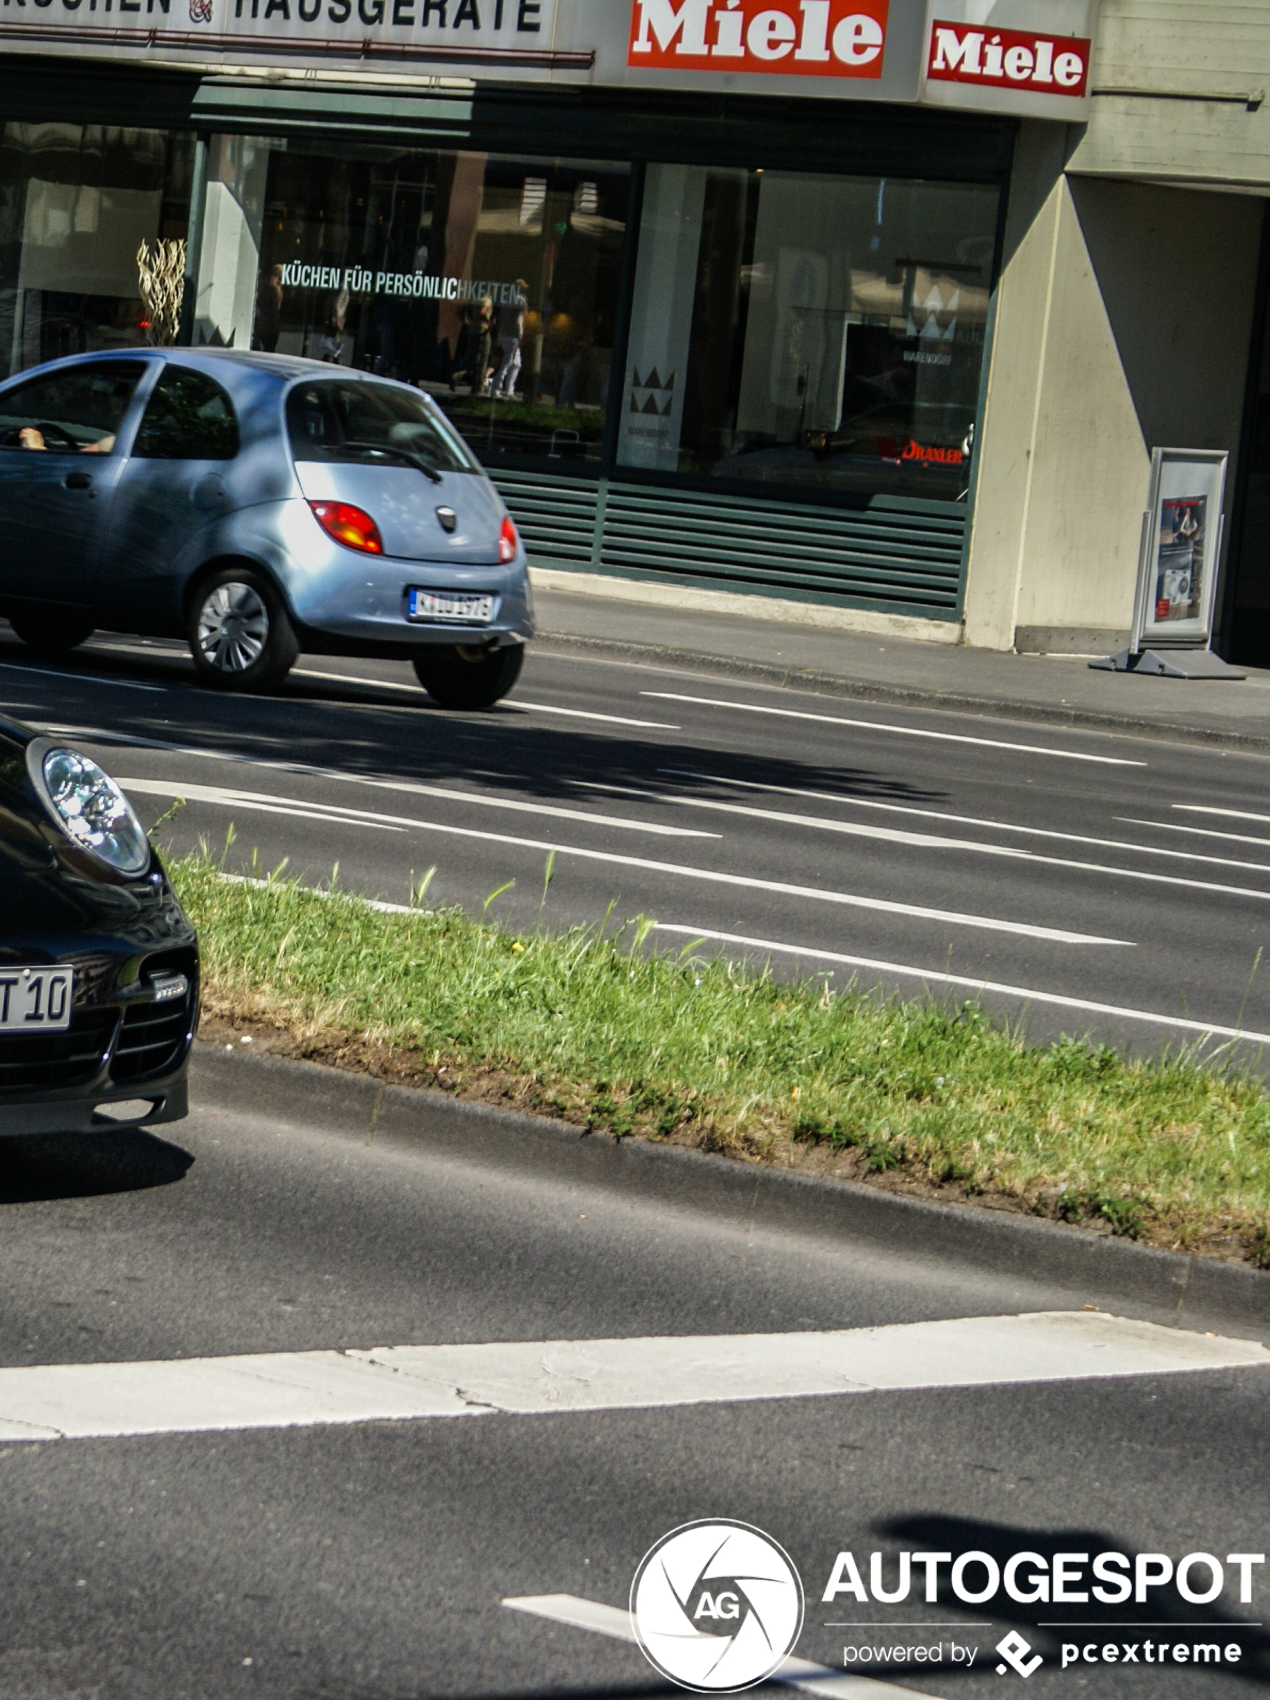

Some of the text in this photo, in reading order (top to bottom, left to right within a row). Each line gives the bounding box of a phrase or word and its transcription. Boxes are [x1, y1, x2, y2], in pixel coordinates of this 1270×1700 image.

[632, 0, 884, 65] Miele
[932, 28, 1084, 86] Miele
[281, 260, 341, 289] KÜCHEN
[343, 265, 372, 293] FÜR
[903, 350, 953, 367] WARENDORF
[901, 439, 963, 464] DRAXLER
